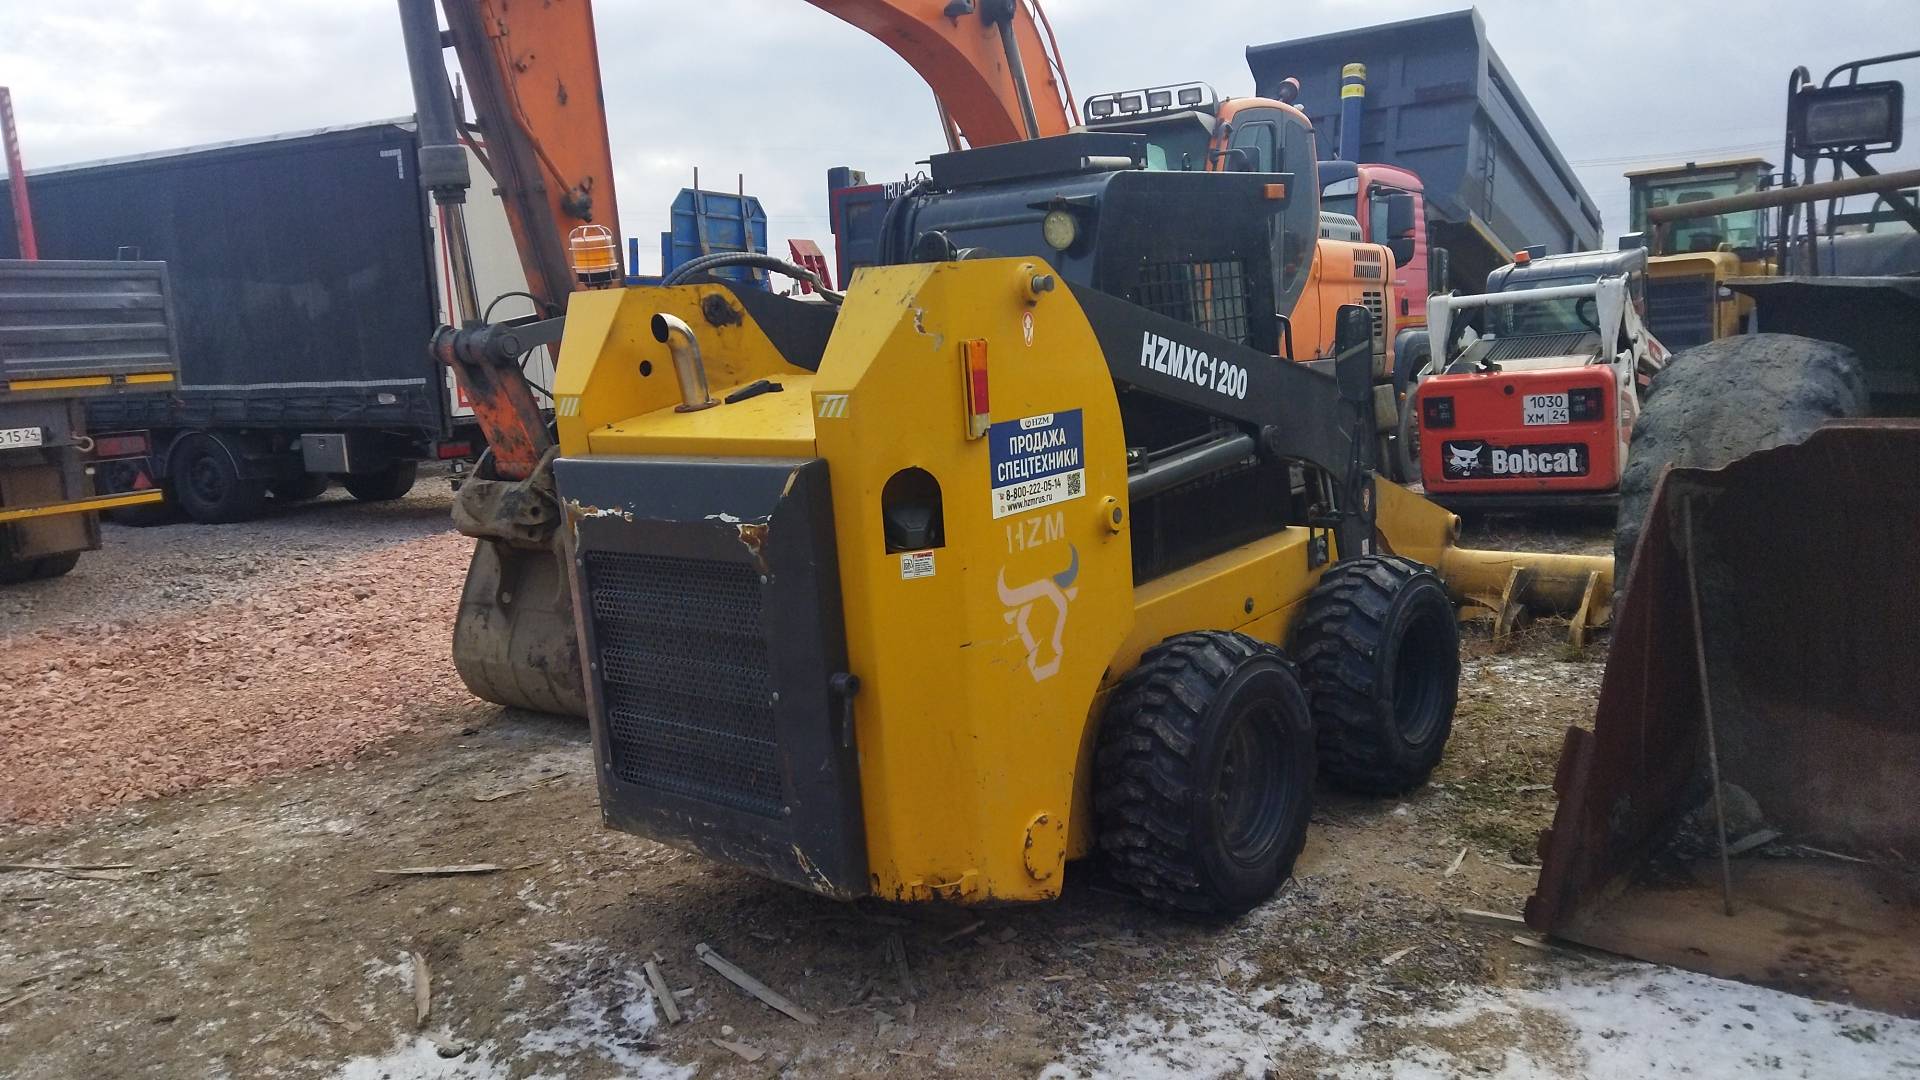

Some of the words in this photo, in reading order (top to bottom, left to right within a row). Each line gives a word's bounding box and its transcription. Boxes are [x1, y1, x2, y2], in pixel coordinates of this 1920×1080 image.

[1141, 331, 1248, 400] HZMXC1200
[1530, 396, 1563, 408] 1030
[1031, 416, 1050, 426] HZM
[1527, 413, 1545, 423] ХМ
[1552, 410, 1567, 420] 24
[24, 429, 37, 439] 24
[1009, 427, 1066, 456] ПРОДАЖА
[997, 447, 1079, 482] СПЕЦТЕХНИКИ
[1492, 448, 1579, 474] Bobcat
[1005, 478, 1062, 501] 8-800-222-05-14
[1007, 495, 1053, 512] www.hzmrus.ru
[1006, 512, 1065, 554] HZM
